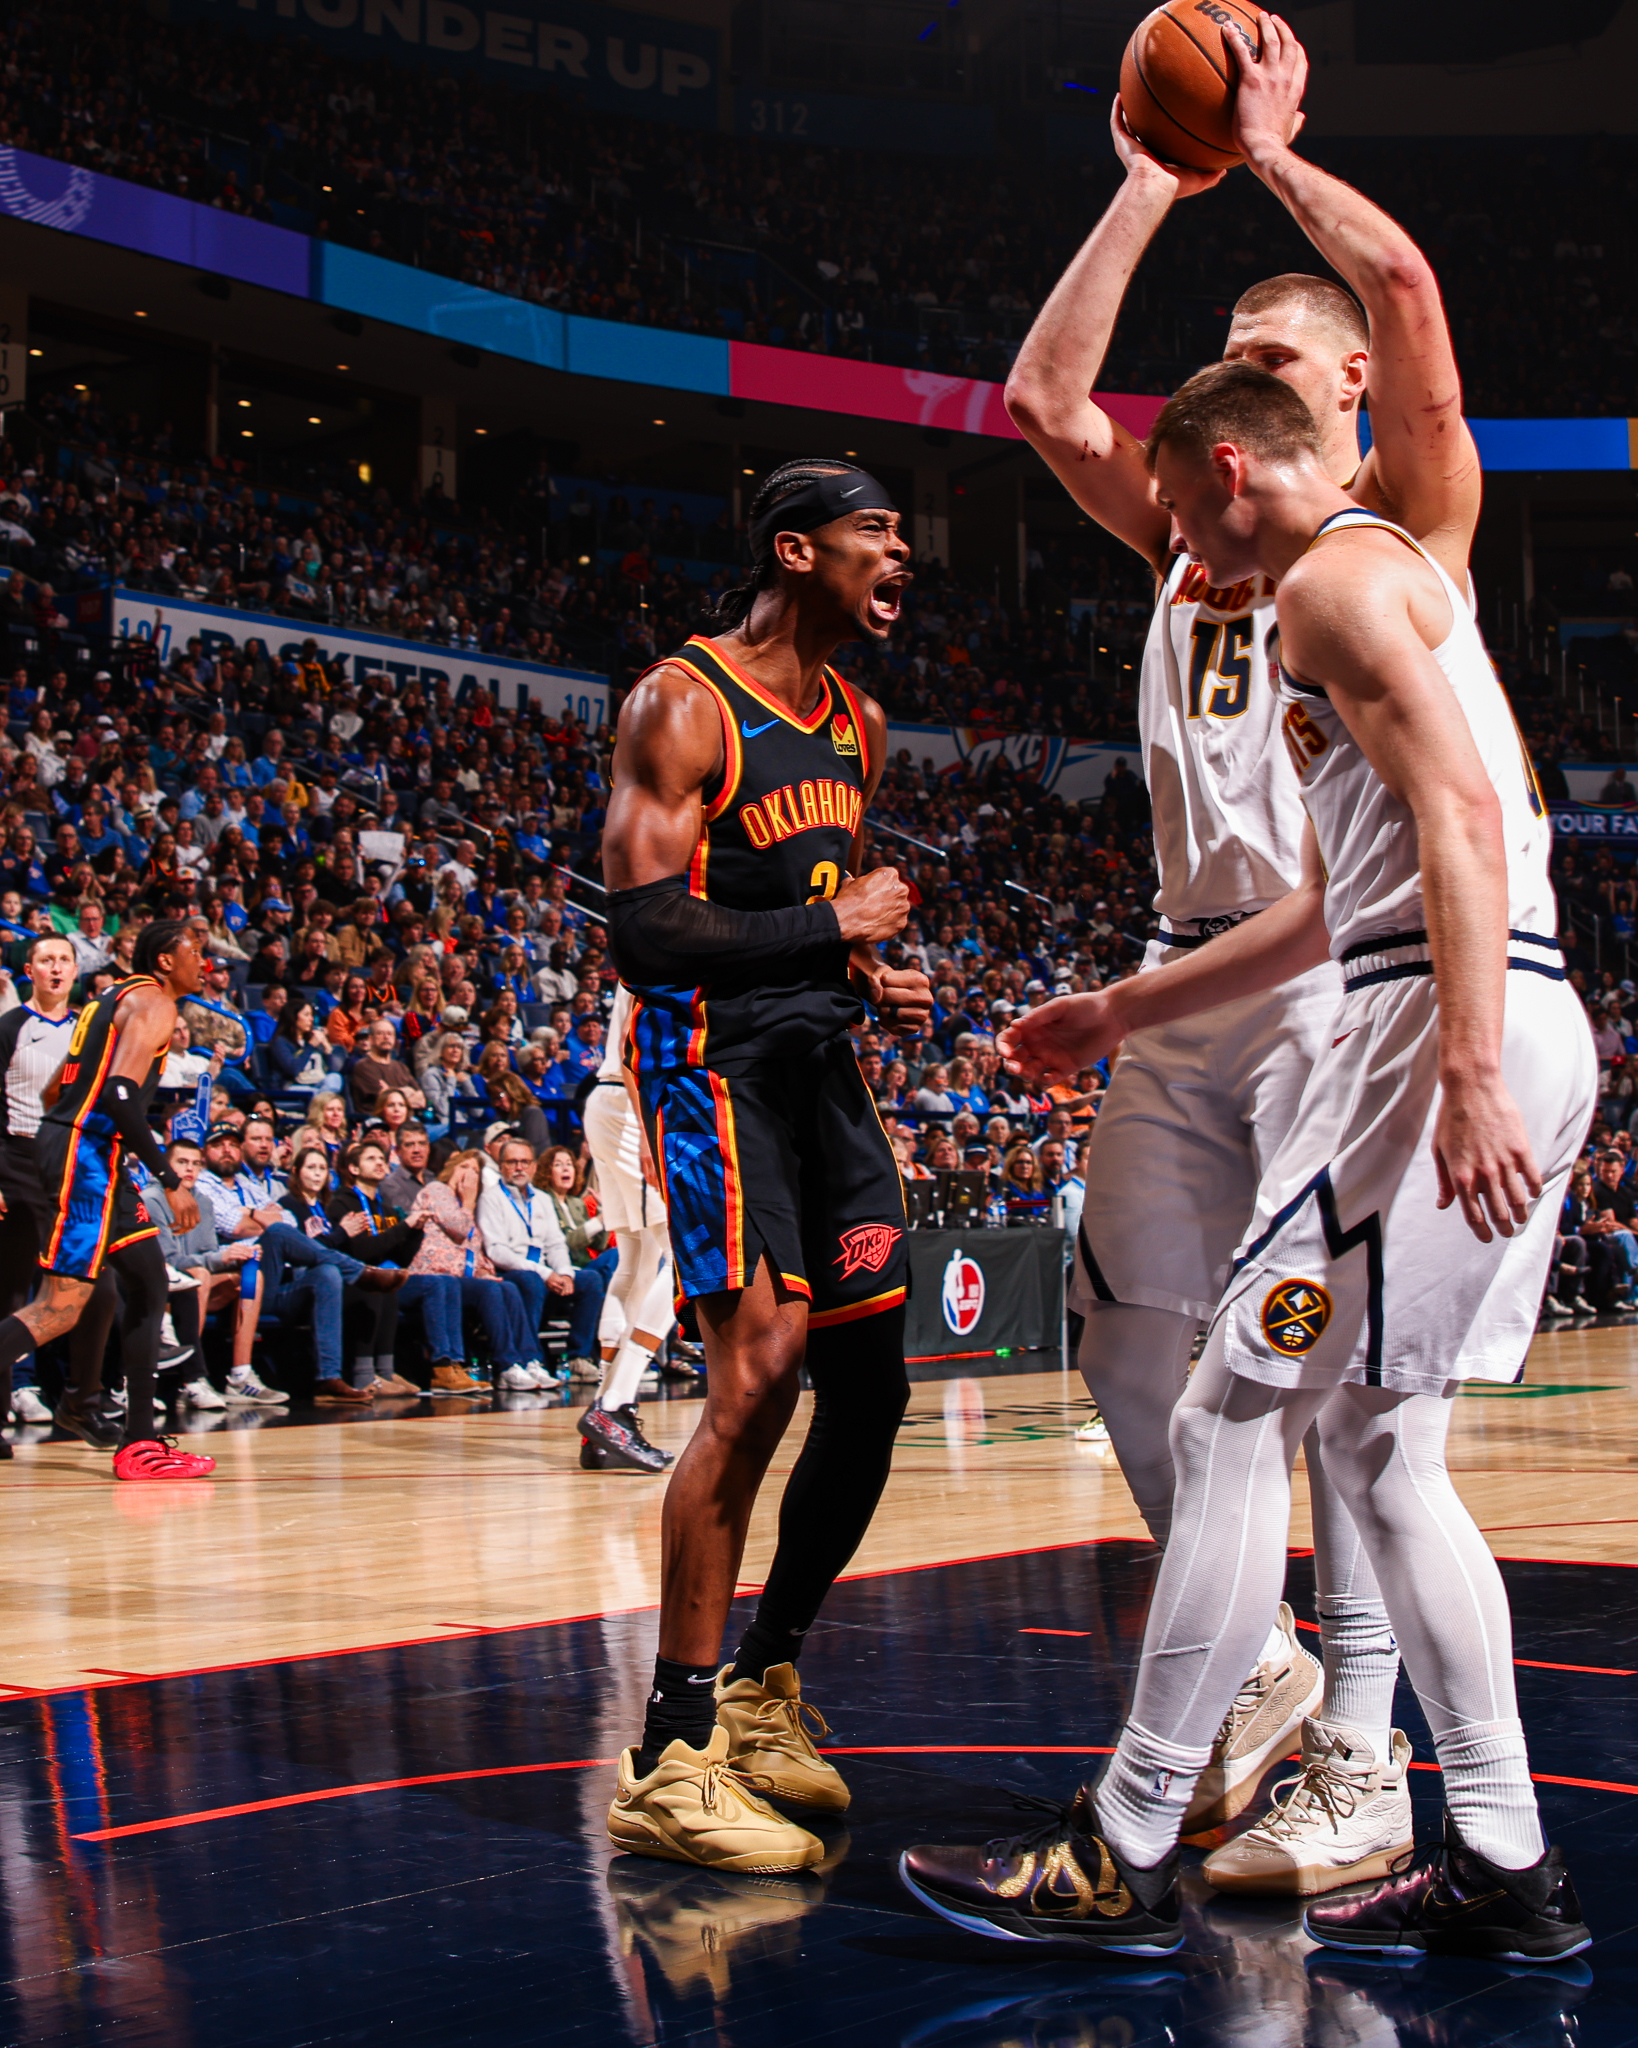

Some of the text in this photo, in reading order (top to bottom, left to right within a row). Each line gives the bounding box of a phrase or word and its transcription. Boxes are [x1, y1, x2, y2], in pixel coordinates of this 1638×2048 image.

[207, 0, 711, 97] UNDER UP
[751, 99, 808, 135] 312
[1187, 614, 1253, 719] 15
[1611, 814, 1638, 834] FA
[69, 1001, 100, 1056] 8
